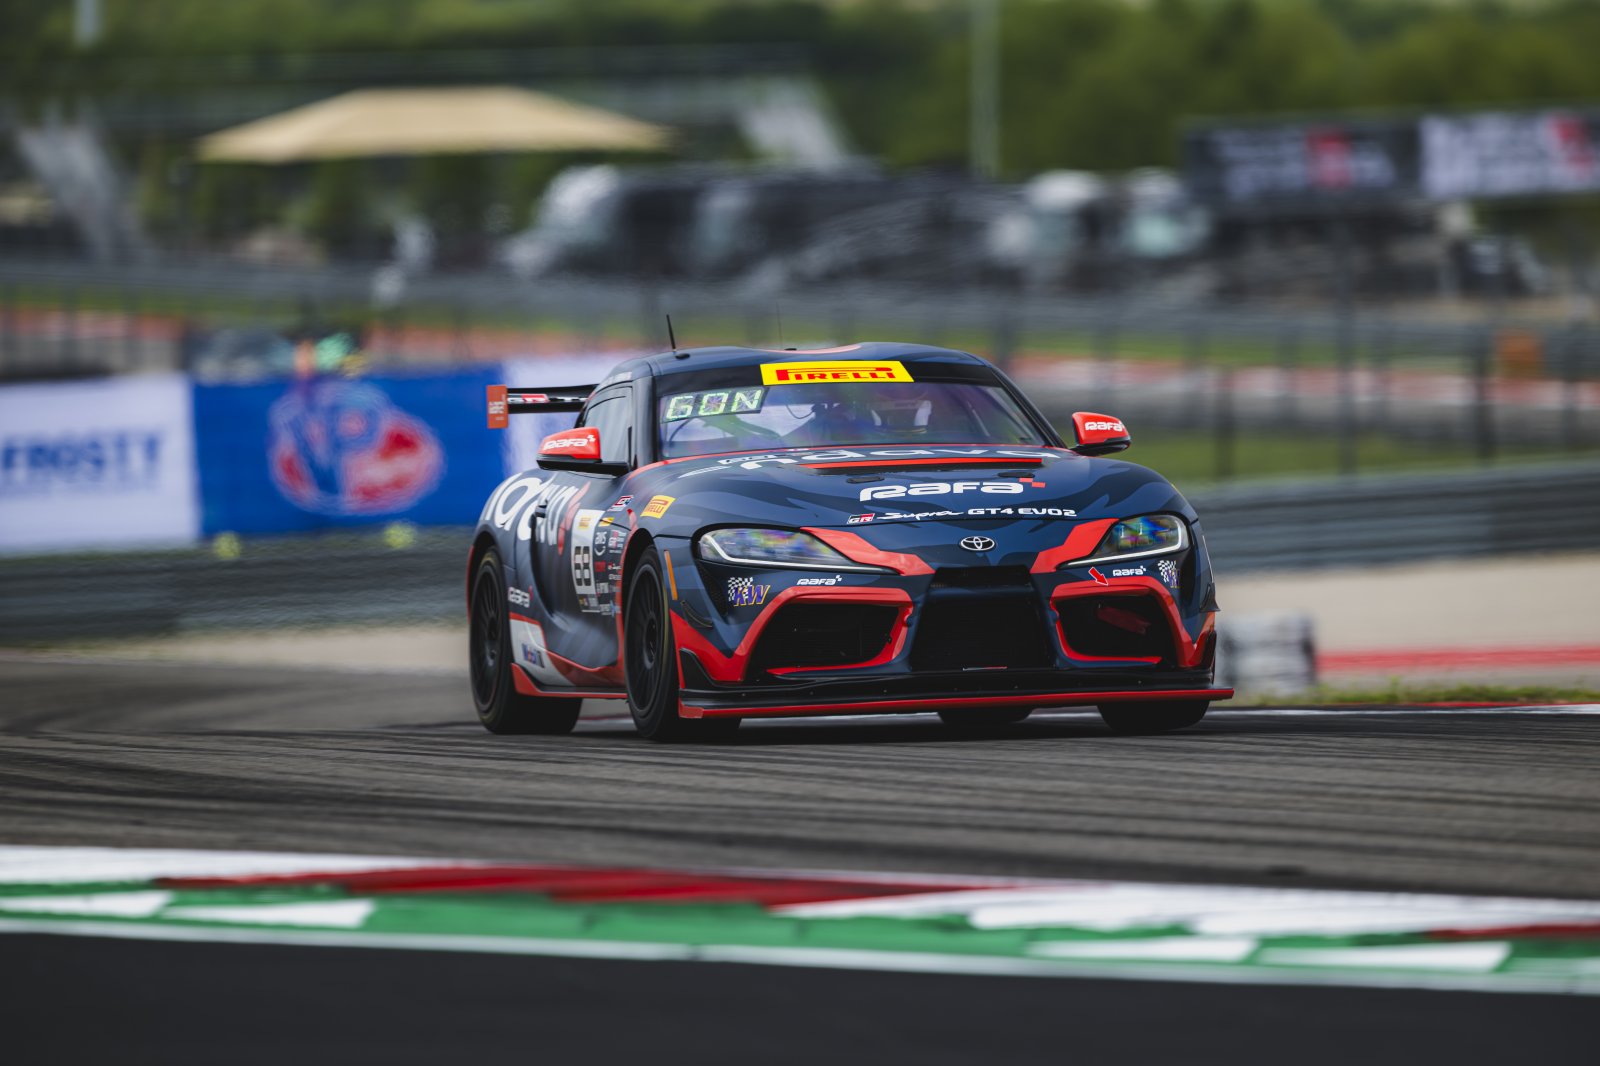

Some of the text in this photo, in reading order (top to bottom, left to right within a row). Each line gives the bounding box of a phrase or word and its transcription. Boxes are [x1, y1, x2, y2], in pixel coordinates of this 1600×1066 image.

[776, 367, 896, 381] PIRELLI
[876, 510, 964, 520] Supra
[1018, 508, 1077, 517] EVO2
[733, 584, 771, 607] KW
